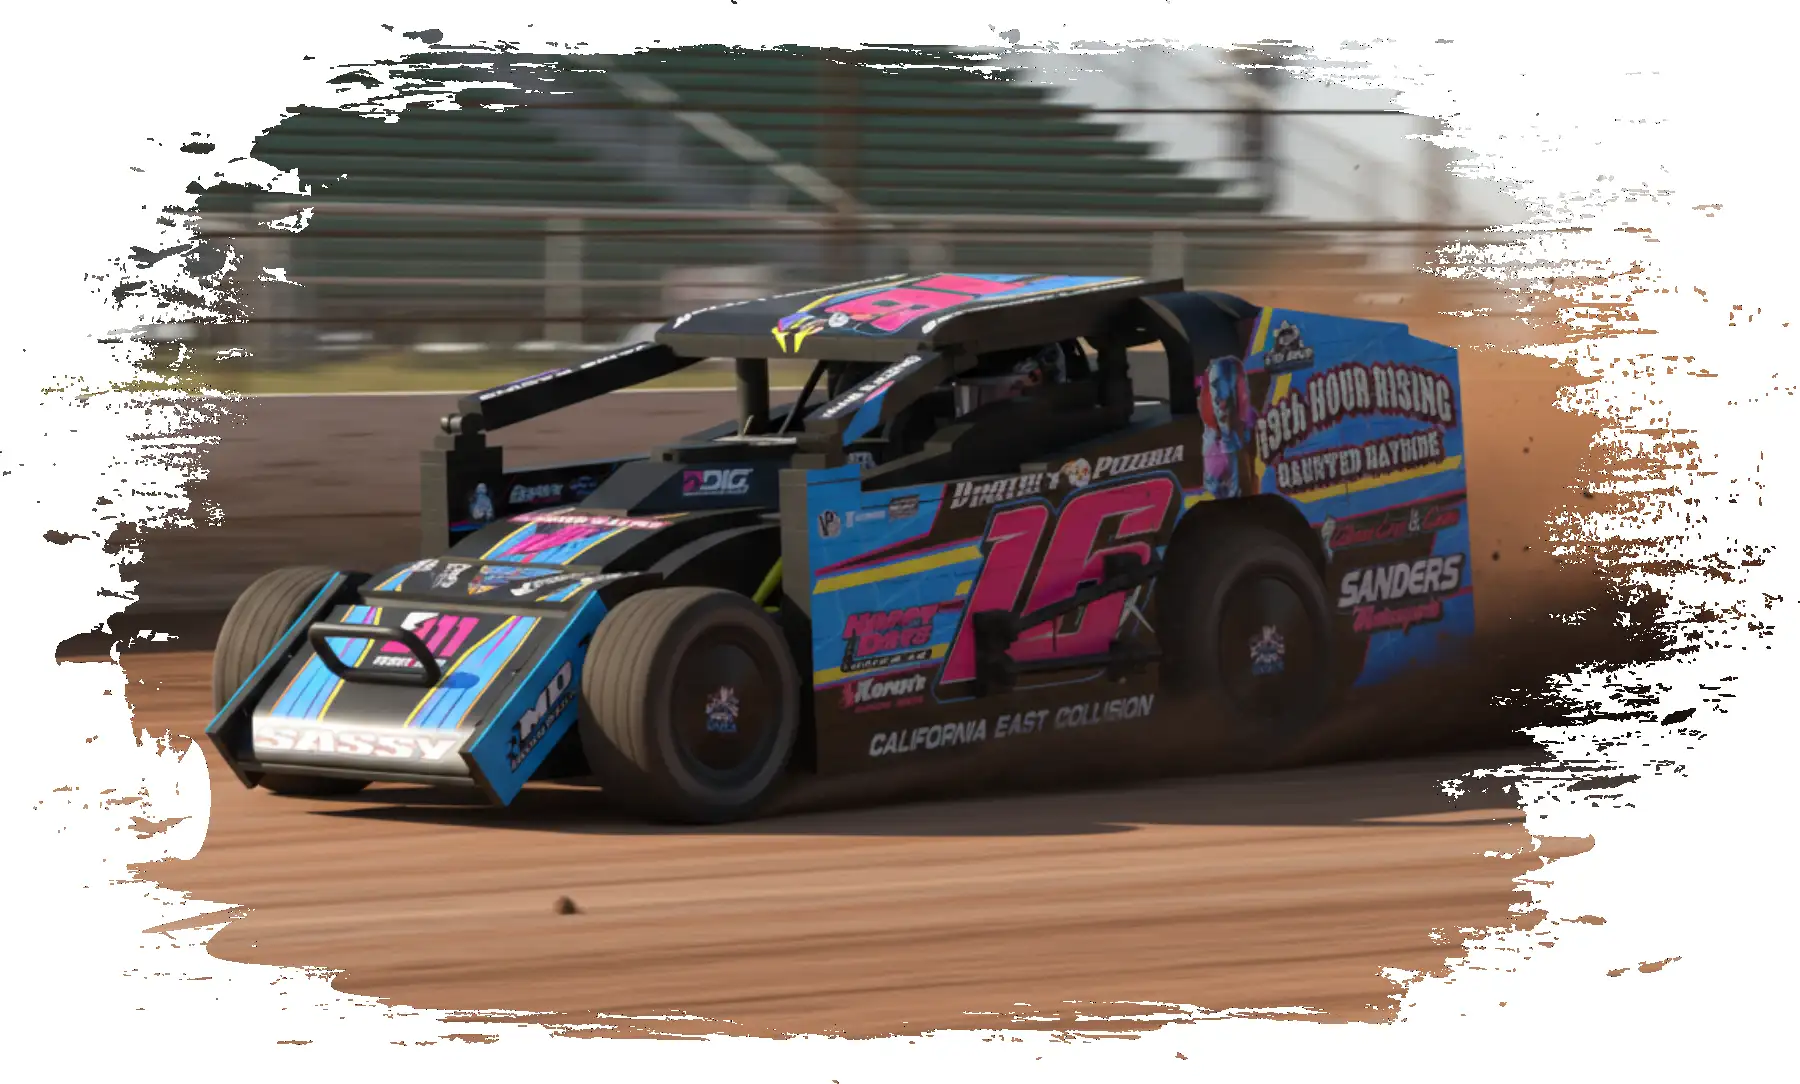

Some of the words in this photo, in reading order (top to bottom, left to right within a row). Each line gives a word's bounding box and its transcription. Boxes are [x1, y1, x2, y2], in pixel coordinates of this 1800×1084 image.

[1309, 366, 1371, 424] HOUR
[1372, 365, 1453, 422] RISING
[940, 478, 1174, 684] 16
[1337, 554, 1463, 609] SANDERS
[254, 725, 457, 761] SASSY
[868, 718, 987, 758] CALIFORNIA
[994, 709, 1050, 739] EAST
[1053, 693, 1155, 730] COLLISION
